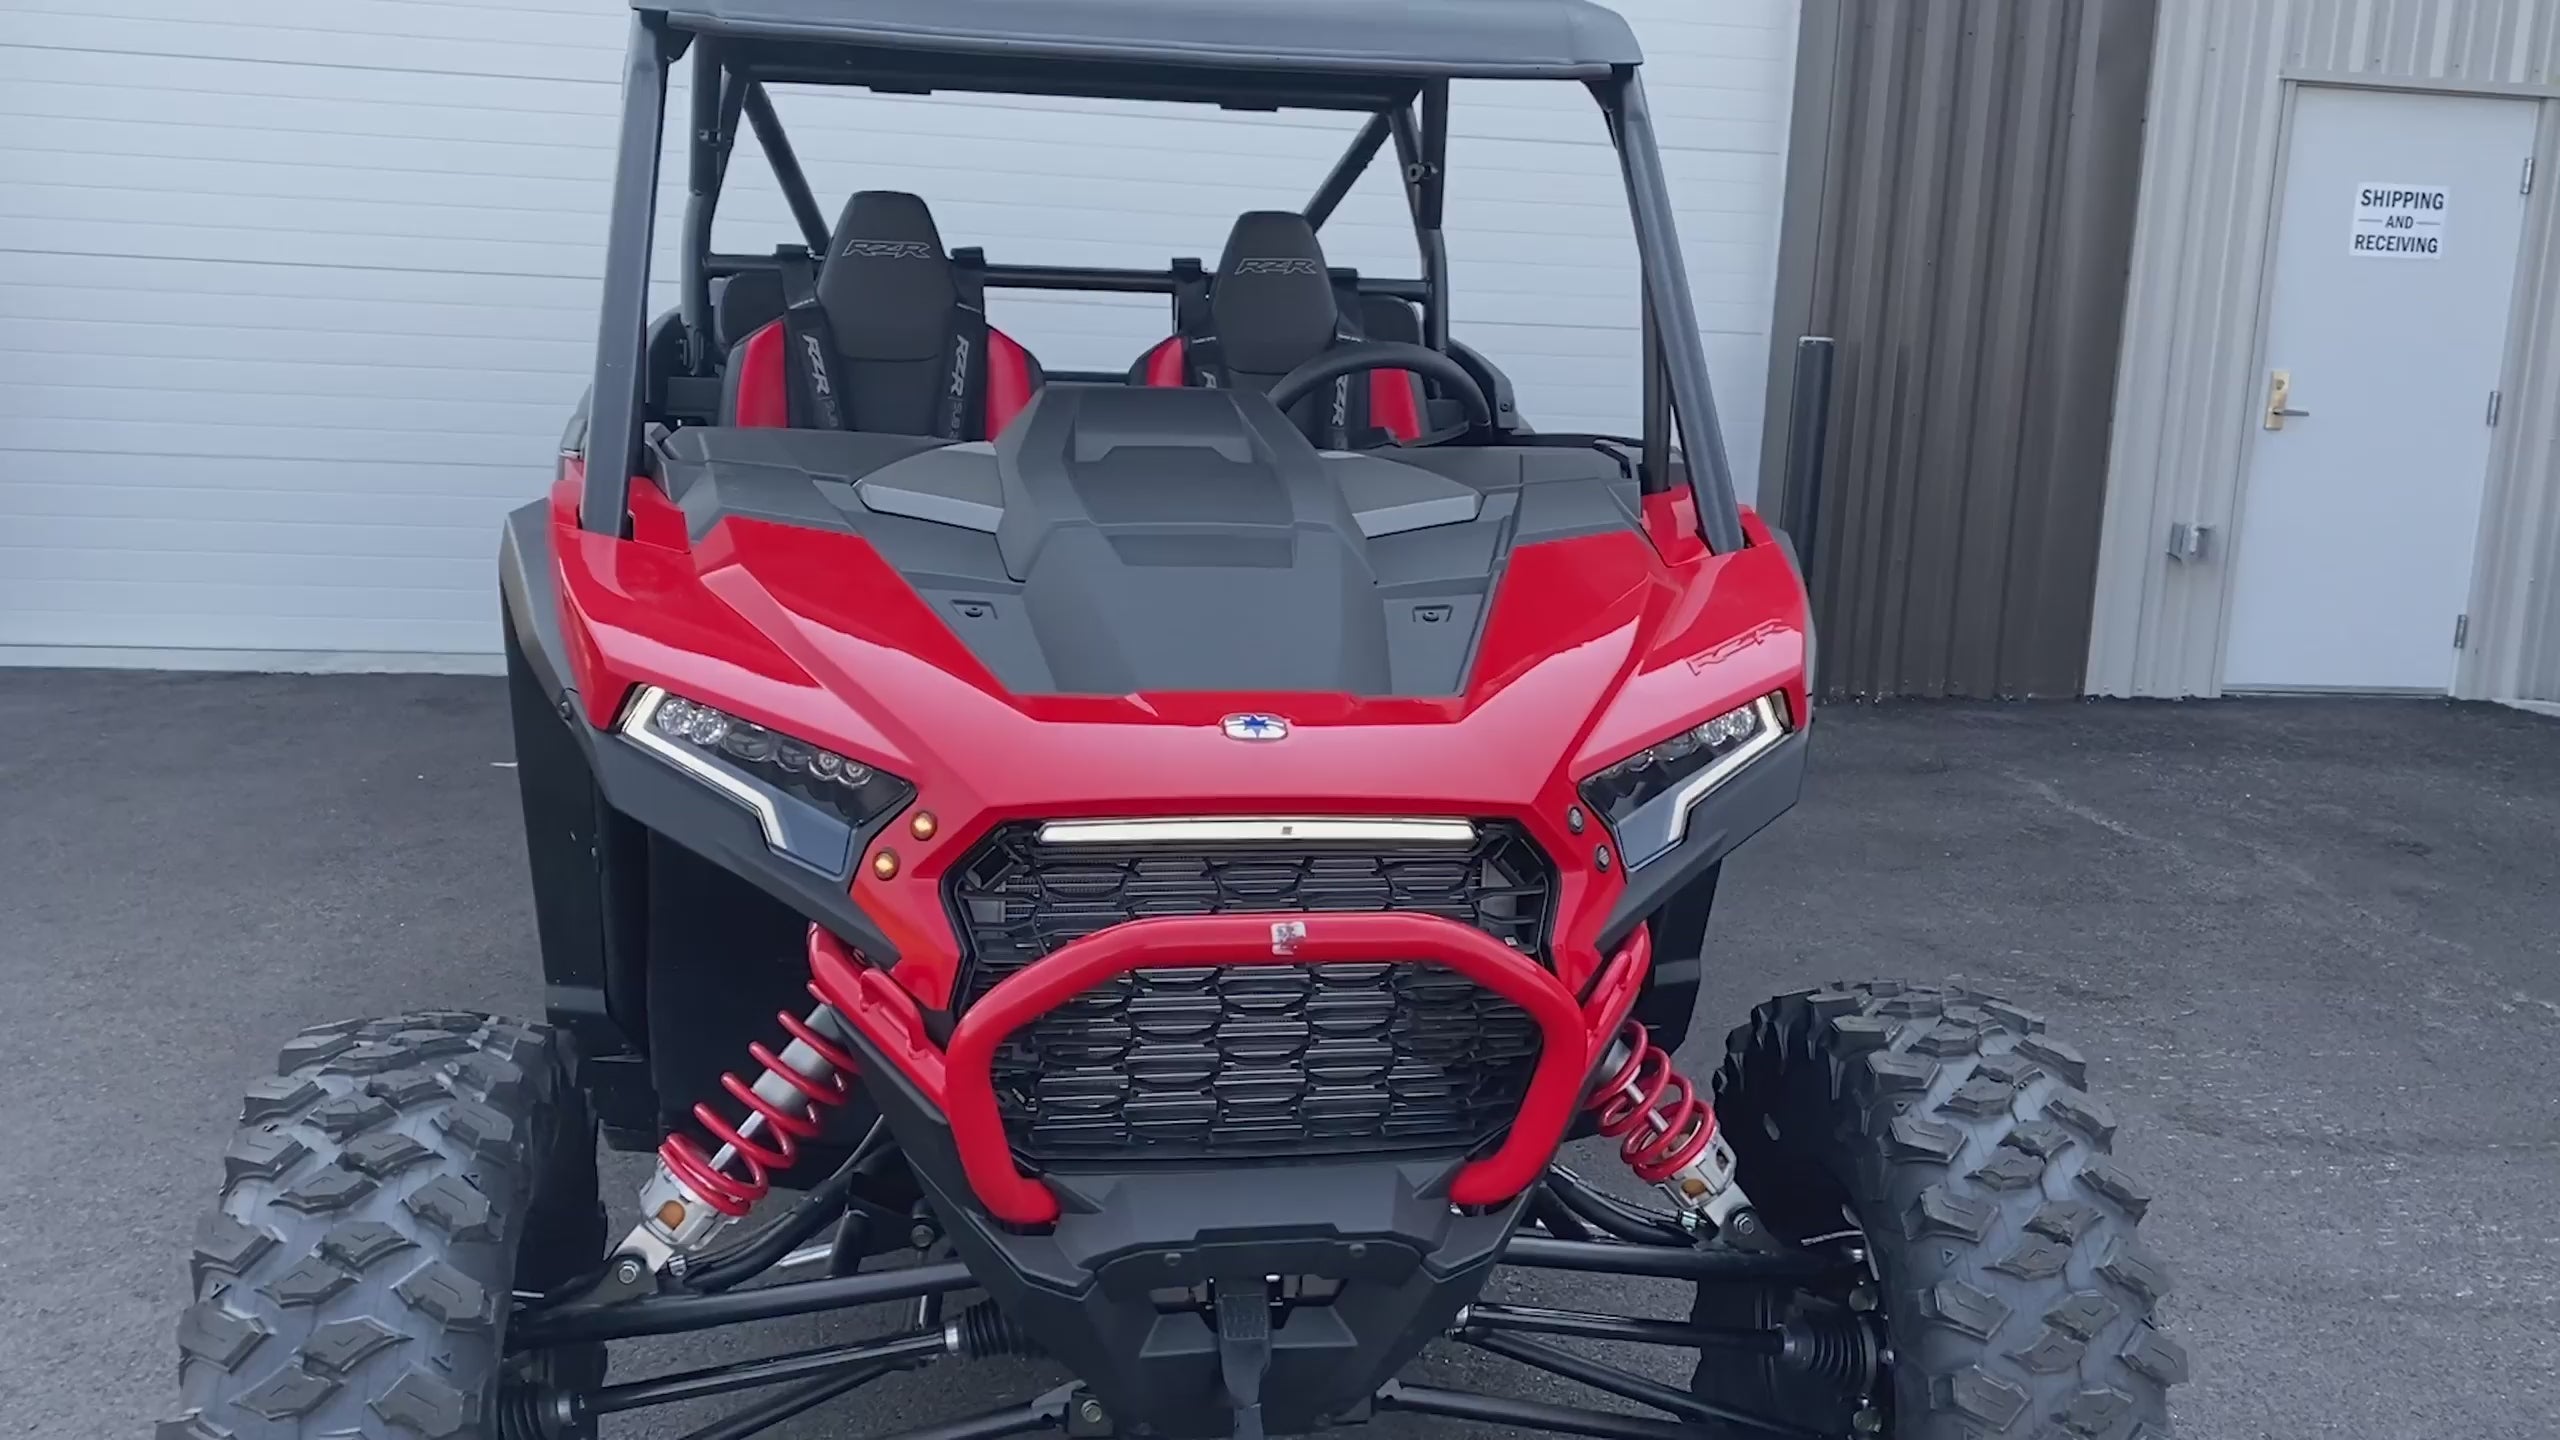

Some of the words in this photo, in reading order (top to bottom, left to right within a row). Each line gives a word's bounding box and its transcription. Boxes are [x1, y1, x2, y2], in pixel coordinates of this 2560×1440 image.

[2361, 189, 2444, 210] SHIPPING
[2385, 215, 2414, 229] AND
[842, 239, 930, 258] RZR
[2354, 234, 2438, 253] RECEIVING
[1234, 258, 1317, 275] RZR
[802, 334, 830, 394] RZR
[950, 334, 969, 396] RZR
